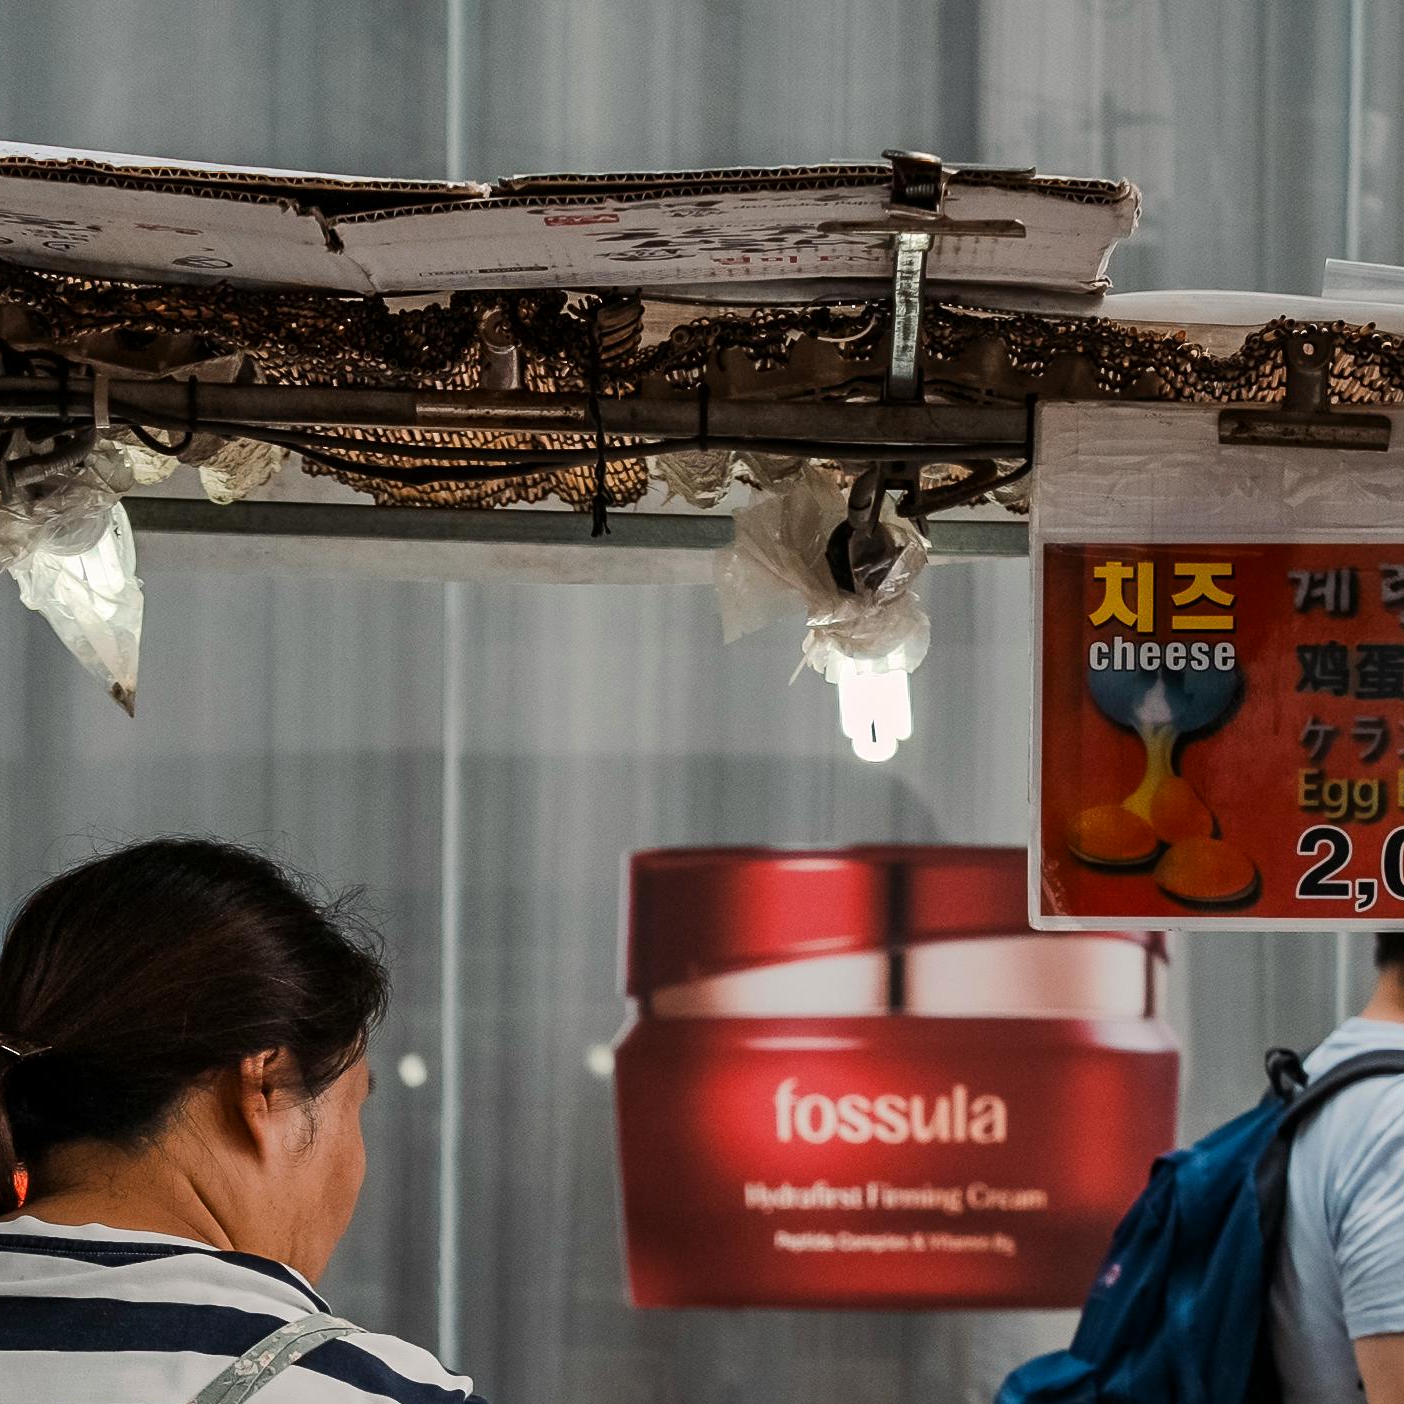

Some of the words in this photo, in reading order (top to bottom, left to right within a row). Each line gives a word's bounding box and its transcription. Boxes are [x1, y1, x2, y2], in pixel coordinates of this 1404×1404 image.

[1088, 561, 1235, 634] 치즈
[1089, 636, 1236, 672] cheese
[1299, 767, 1380, 821] Egg
[775, 1077, 1008, 1144] fossula
